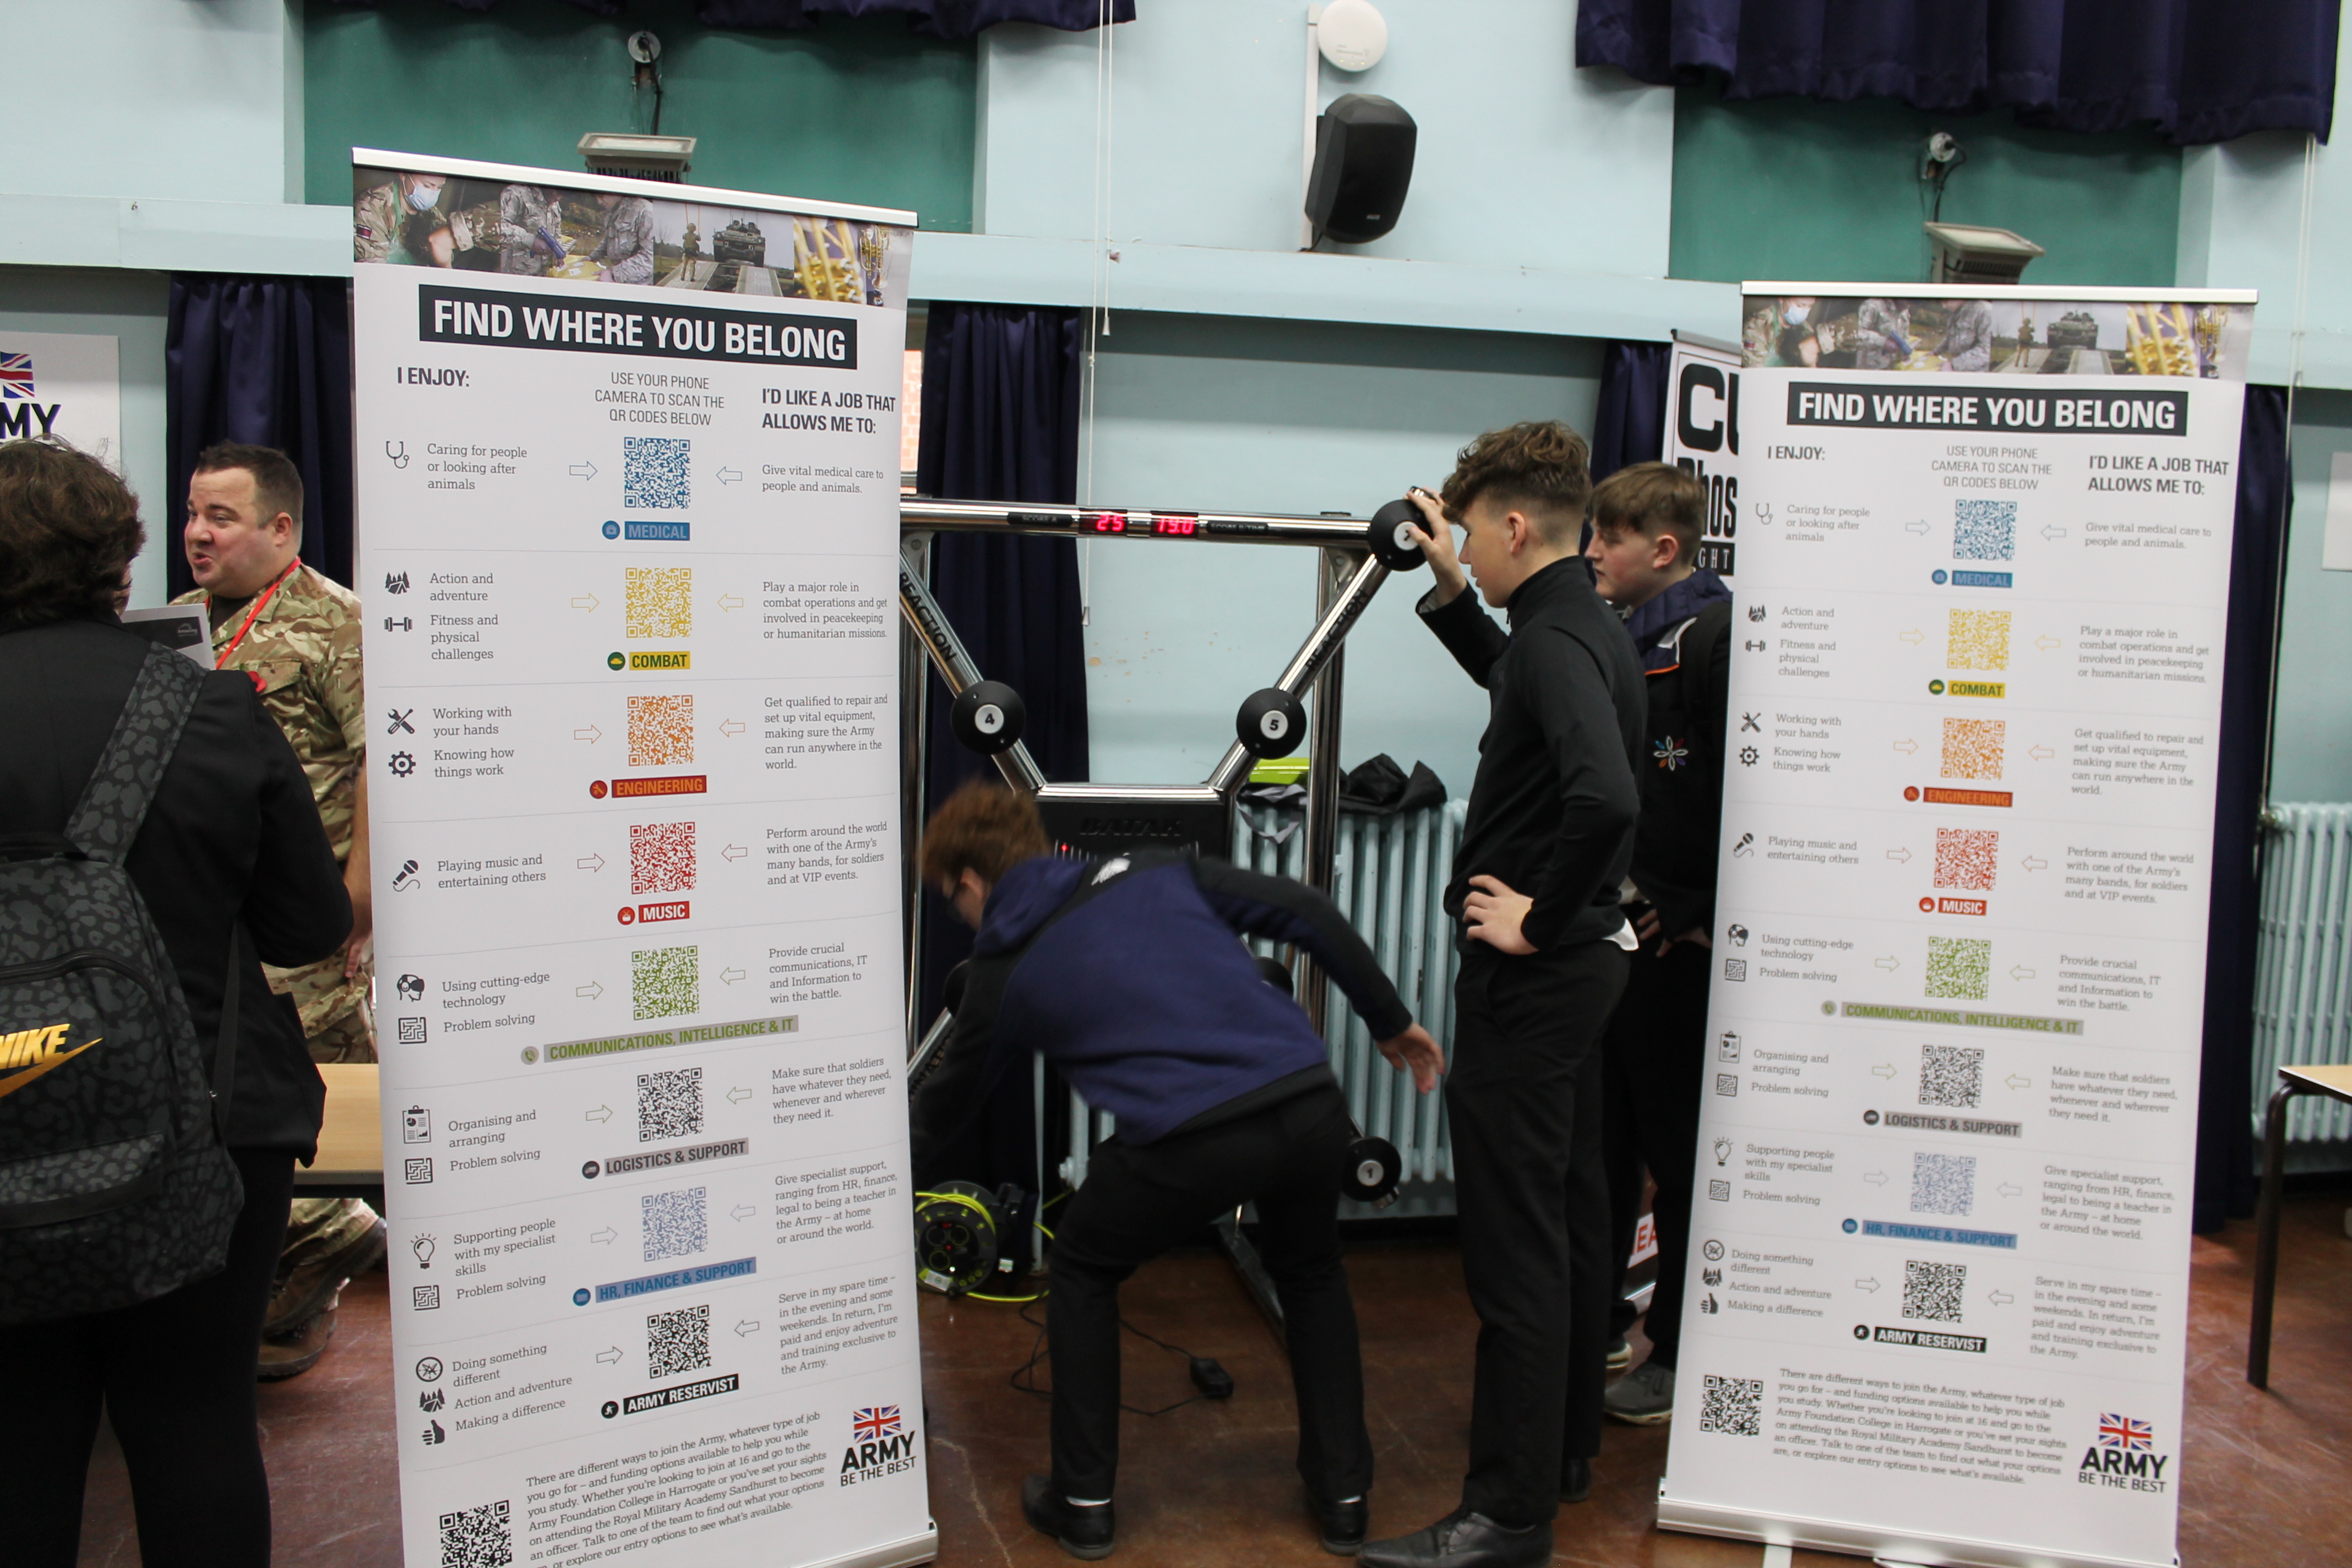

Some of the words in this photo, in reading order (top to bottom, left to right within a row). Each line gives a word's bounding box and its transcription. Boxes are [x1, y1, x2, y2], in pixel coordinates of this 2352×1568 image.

[434, 300, 513, 337] FIND
[522, 307, 643, 347] WHERE
[651, 316, 715, 352] YOU
[725, 322, 845, 361] BELONG
[398, 367, 402, 384] I
[407, 367, 470, 387] ENJOY:
[611, 372, 634, 385] USE
[636, 373, 668, 387] YOUR
[671, 375, 709, 390] PHONE
[595, 389, 647, 404] CAMERA
[650, 393, 665, 405] TO
[668, 393, 700, 407] SCAN
[703, 395, 725, 409] THE
[763, 388, 781, 404] I'D
[786, 389, 818, 406] LIKE
[821, 391, 832, 407] A
[835, 393, 863, 409] JOB
[865, 394, 896, 412] THAT
[609, 409, 626, 422] QR
[629, 410, 667, 424] CODES
[671, 412, 711, 426] BELOW
[1799, 392, 1865, 421] FIND
[1872, 395, 1978, 424] WHERE
[1985, 398, 2046, 427] YOU
[2055, 399, 2175, 429] BELONG
[762, 413, 827, 431] ALLOWS
[831, 416, 853, 432] ME
[856, 417, 876, 434] TO:
[427, 443, 468, 458] Caring
[471, 444, 487, 456] for
[490, 447, 527, 459] people
[1767, 446, 1772, 459] I
[1776, 445, 1825, 460] ENJOY:
[1947, 445, 1967, 456] USE
[1970, 446, 1999, 458] YOUR
[2001, 447, 2038, 459] PHONE
[427, 463, 440, 472] or
[443, 460, 487, 475] looking
[490, 462, 516, 474] after
[762, 464, 786, 475] Give
[788, 465, 812, 476] vital
[815, 466, 853, 477] medical
[855, 470, 874, 478] care
[876, 470, 884, 480] to
[1931, 460, 1979, 472] CAMERA
[1981, 462, 1995, 473] TO
[1998, 462, 2029, 474] SCAN
[2031, 464, 2052, 475] THE
[2089, 455, 2108, 469] I'D
[2112, 456, 2143, 470] LIKE
[2147, 456, 2158, 470] A
[2162, 458, 2191, 472] JOB
[2195, 459, 2229, 475] THAT
[427, 478, 475, 489] animals
[762, 480, 797, 493] people
[799, 481, 819, 492] and
[821, 482, 862, 493] animals.
[1943, 476, 1959, 487] QR
[1961, 476, 1996, 489] CODES
[1999, 478, 2039, 490] BELOW
[2088, 477, 2152, 492] ALLOWS
[2156, 478, 2180, 493] ME
[2183, 480, 2204, 495] TO:
[629, 525, 687, 539] MEDICAL
[1096, 514, 1125, 532] 25
[1955, 571, 2009, 587] MEDICAL
[900, 572, 956, 661] REACTION
[632, 654, 687, 668] COMBAT
[1951, 683, 2002, 696] COMBAT
[432, 707, 483, 720] Working
[486, 706, 512, 717] with
[985, 713, 995, 725] 4
[1776, 713, 1817, 726] Working
[1820, 716, 1842, 726] with
[433, 728, 460, 738] your
[464, 723, 499, 735] hands
[1269, 719, 1280, 731] 5
[1774, 729, 1797, 738] your
[1799, 728, 1830, 739] hands
[616, 778, 703, 796] ENGINEERING
[1928, 790, 2010, 806] ENGINEERING
[437, 859, 482, 873] Playing
[485, 856, 519, 868] music
[521, 853, 543, 865] and
[438, 874, 508, 889] entertaining
[511, 871, 546, 883] others
[643, 904, 685, 921] MUSIC
[1942, 900, 1983, 914] MUSIC
[1759, 967, 1799, 979] Problem
[1802, 971, 1837, 983] solving
[1846, 1004, 1962, 1025] COMMUNICATIONS,
[1966, 1014, 2050, 1031] INTELLIGENCE
[2052, 1020, 2063, 1032] &
[2067, 1021, 2078, 1033] IT
[550, 1033, 677, 1060] COMMUNICATIONS,
[679, 1022, 766, 1043] INTELLIGENCE
[769, 1020, 779, 1032] &
[781, 1019, 794, 1031] IT
[1885, 1114, 1946, 1130] LOGISTICS
[1949, 1119, 1959, 1131] &
[1962, 1120, 2019, 1136] SUPPORT
[606, 1152, 672, 1174] LOGISTICS
[674, 1150, 685, 1163] &
[688, 1141, 747, 1161] SUPPORT
[1366, 1167, 1373, 1179] 1
[1866, 1223, 1885, 1237] HR,
[1888, 1225, 1941, 1241] FINANCE
[1943, 1230, 1953, 1242] &
[1957, 1232, 2013, 1248] SUPPORT
[600, 1286, 621, 1300] HR,
[624, 1274, 680, 1295] FINANCE
[682, 1272, 692, 1284] &
[695, 1261, 753, 1282] SUPPORT
[1878, 1329, 1916, 1344] ARMY
[1918, 1333, 1984, 1352] RESERVIST
[627, 1392, 667, 1413] ARMY
[669, 1377, 736, 1403] RESERVIST
[455, 1415, 499, 1431] Making
[502, 1413, 509, 1421] a
[512, 1400, 565, 1418] difference
[526, 1474, 556, 1487] There
[559, 1470, 575, 1480] are
[578, 1458, 619, 1476] different
[621, 1453, 647, 1465] ways
[649, 1450, 658, 1458] to
[661, 1445, 678, 1458] join
[680, 1441, 696, 1451] the
[698, 1435, 727, 1447] Army,
[728, 1424, 771, 1439] whatever
[772, 1419, 793, 1431] type
[795, 1414, 804, 1424] of
[806, 1411, 820, 1424] job
[841, 1430, 916, 1474] ARMY
[841, 1473, 856, 1487] BE
[859, 1466, 884, 1481] THE
[887, 1456, 917, 1475] BEST
[2081, 1447, 2168, 1479] ARMY
[2079, 1472, 2096, 1485] BE
[2100, 1474, 2127, 1489] THE
[2132, 1479, 2167, 1493] BEST
